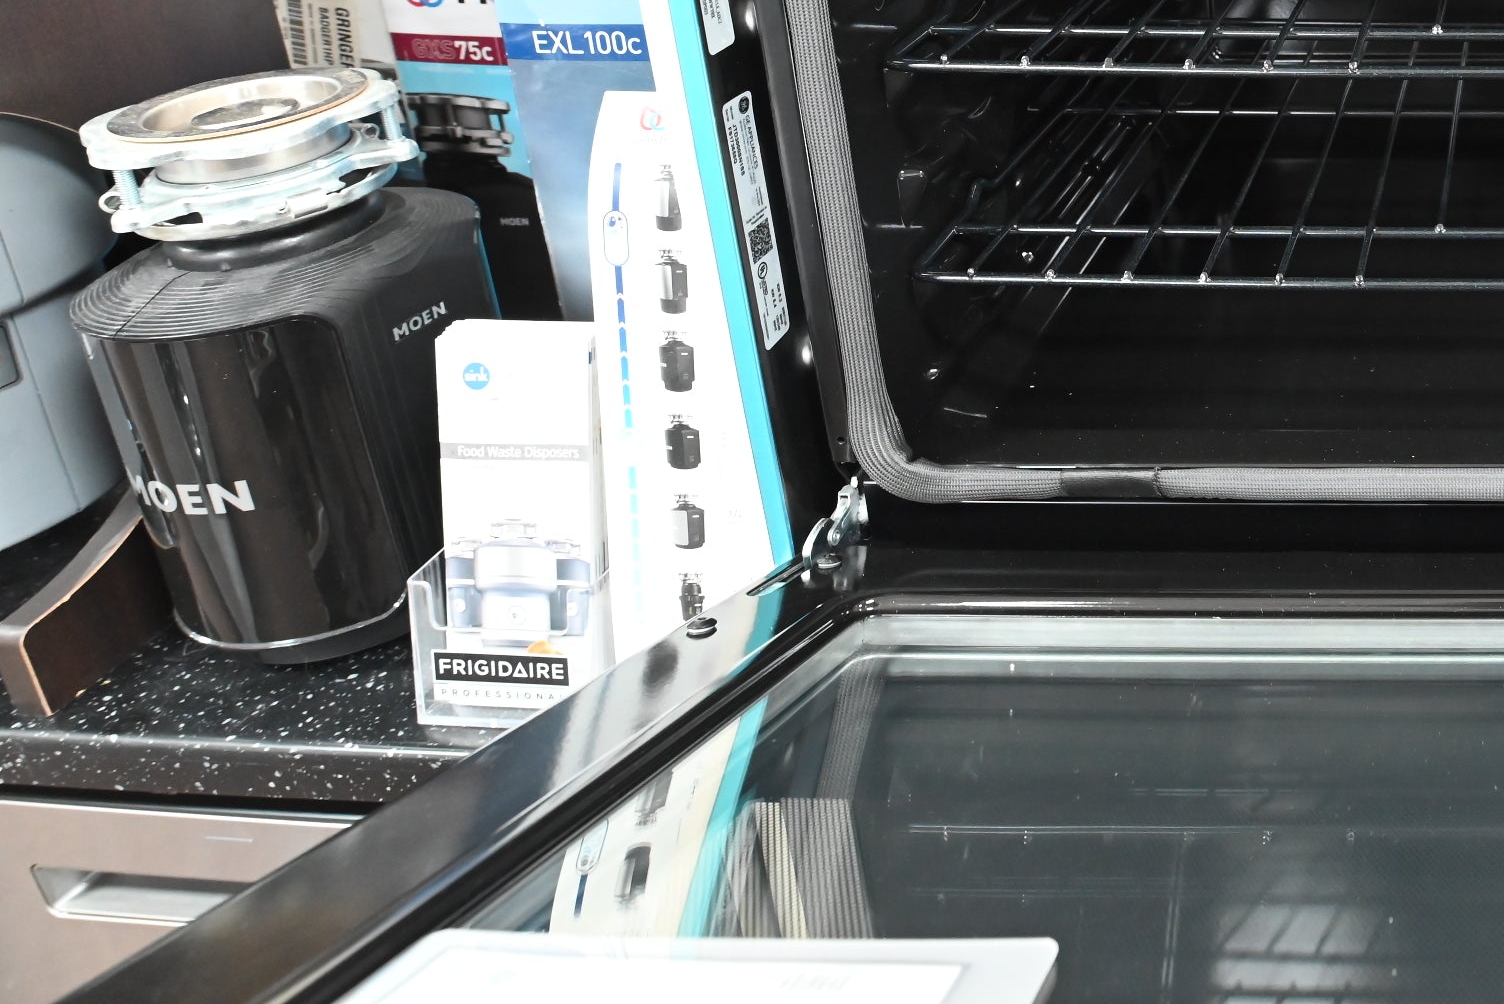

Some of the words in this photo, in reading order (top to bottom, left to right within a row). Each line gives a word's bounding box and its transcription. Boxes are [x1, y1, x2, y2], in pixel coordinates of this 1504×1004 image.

[500, 217, 530, 226] MOEN
[392, 301, 448, 341] MOEN
[464, 366, 488, 382] sink
[457, 445, 485, 458] Food
[487, 446, 521, 458] Waste
[525, 446, 580, 460] Disposers
[135, 475, 256, 515] MOEN
[438, 658, 565, 680] FRIGIDAIRE
